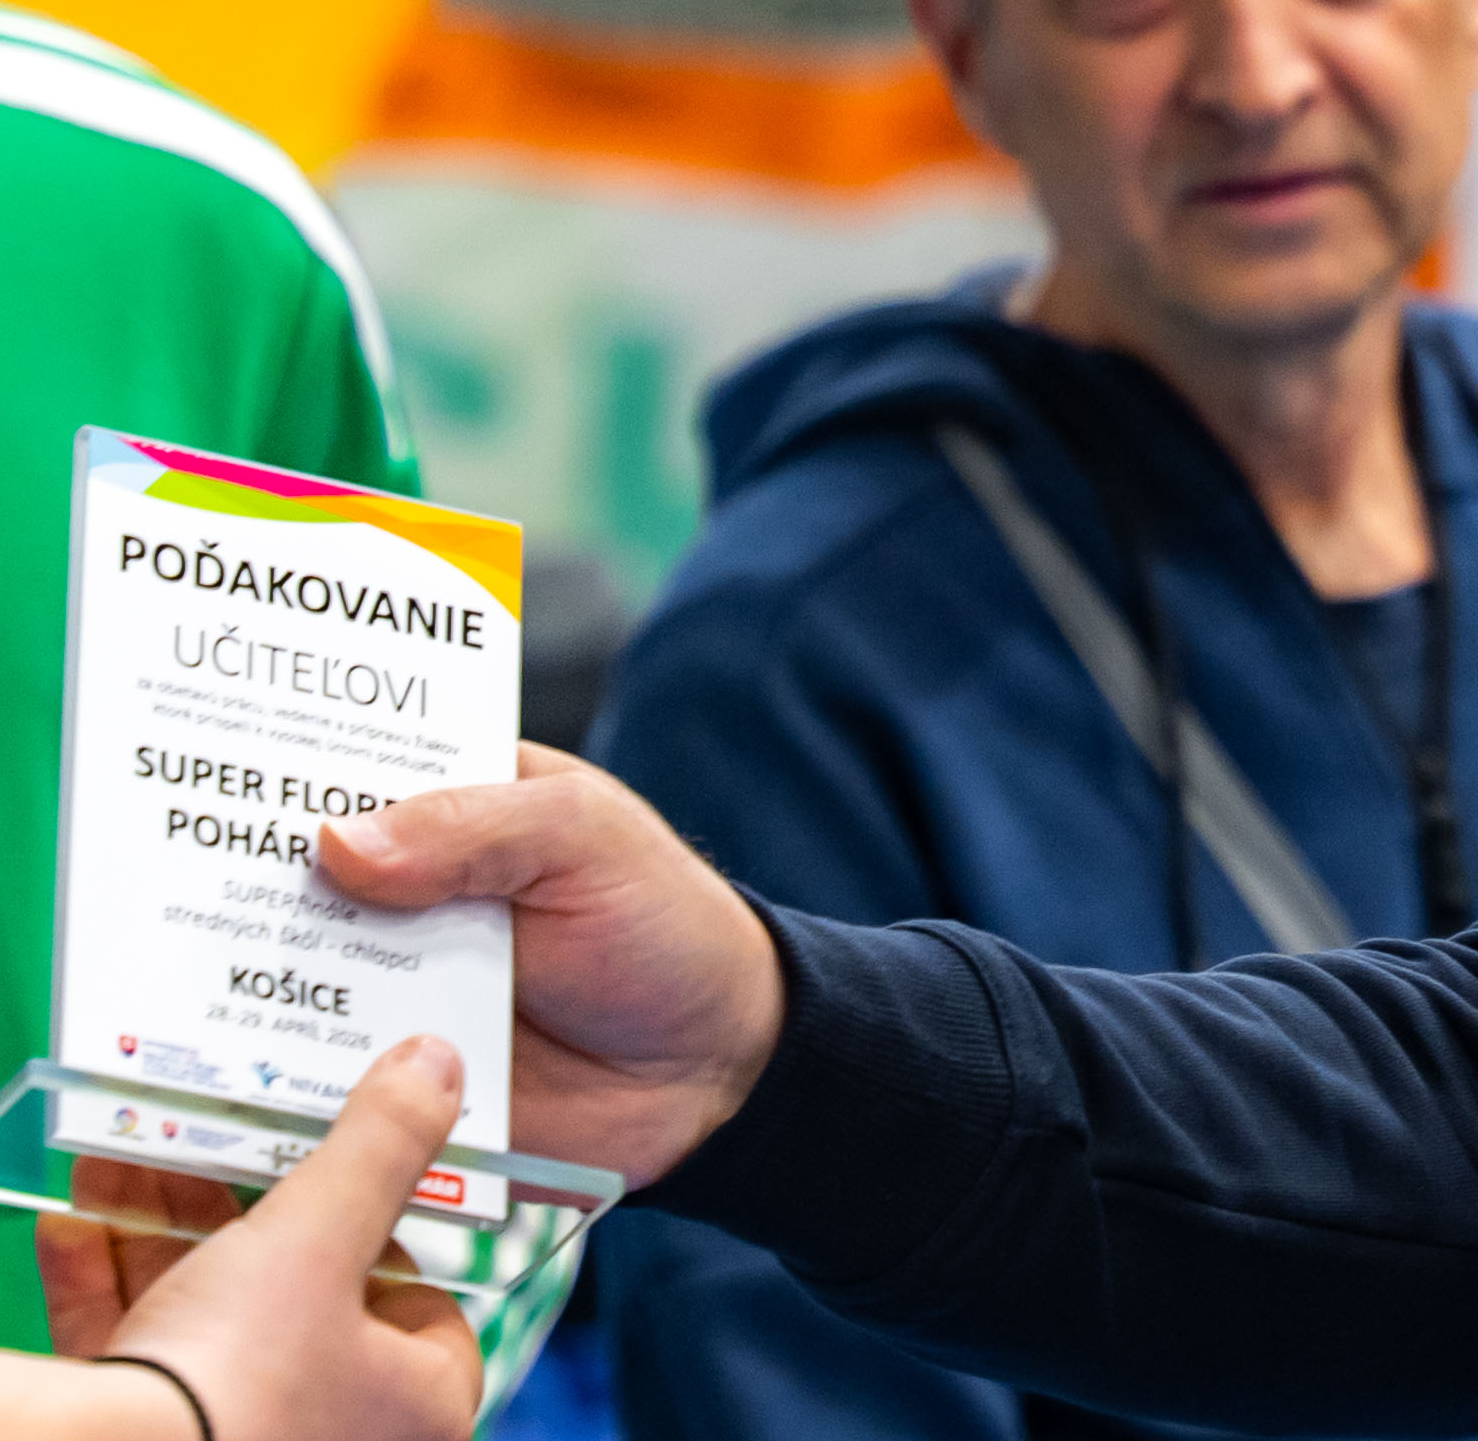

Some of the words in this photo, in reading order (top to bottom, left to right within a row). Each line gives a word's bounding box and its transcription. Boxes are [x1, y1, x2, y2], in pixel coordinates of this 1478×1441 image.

[120, 534, 485, 650] POĎAKOVANIE
[174, 622, 427, 718] UČITEĽOVI
[134, 745, 265, 802] SUPER
[280, 776, 399, 818] FLOR
[167, 808, 312, 868] POHÁR
[229, 964, 351, 1016] KOŠICE
